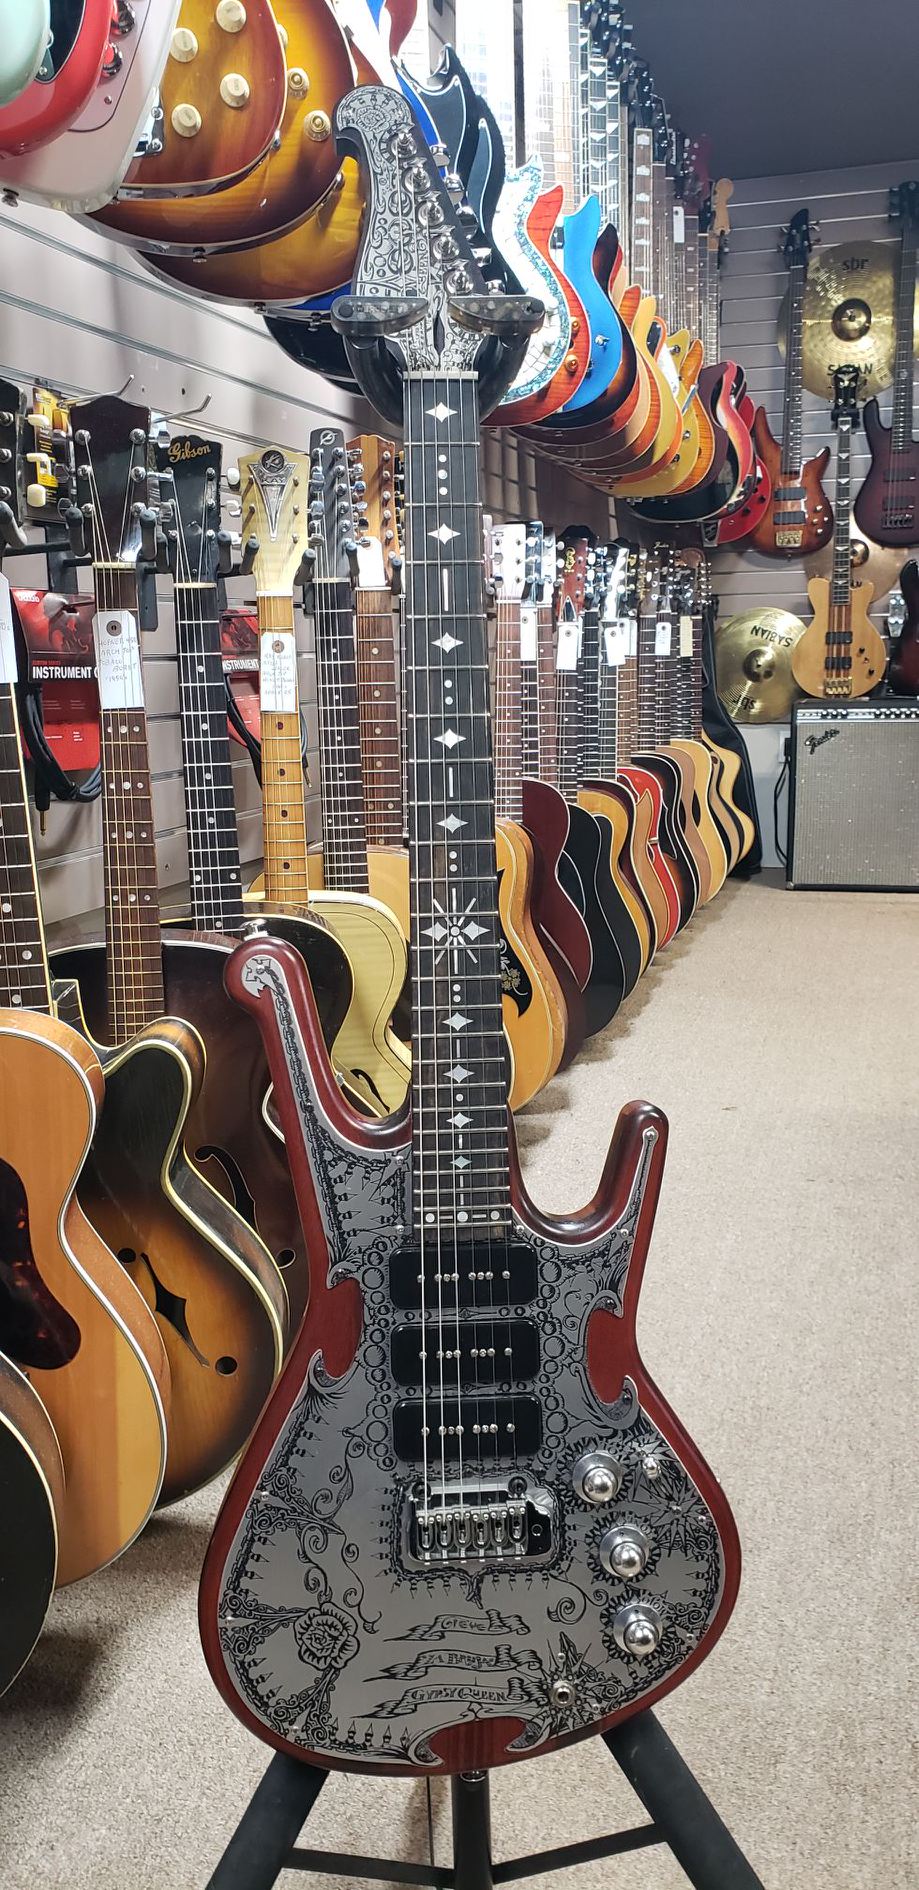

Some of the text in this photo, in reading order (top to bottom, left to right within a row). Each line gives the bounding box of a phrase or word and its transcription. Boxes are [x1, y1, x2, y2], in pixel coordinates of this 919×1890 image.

[842, 257, 870, 271] sbr
[167, 441, 212, 463] Gibson
[751, 625, 794, 648] SABIAN
[32, 666, 92, 679] INSTRUMENT
[732, 694, 757, 711] sbr
[804, 728, 840, 755] Fender
[412, 1687, 508, 1702] GYPSY QUEEN
